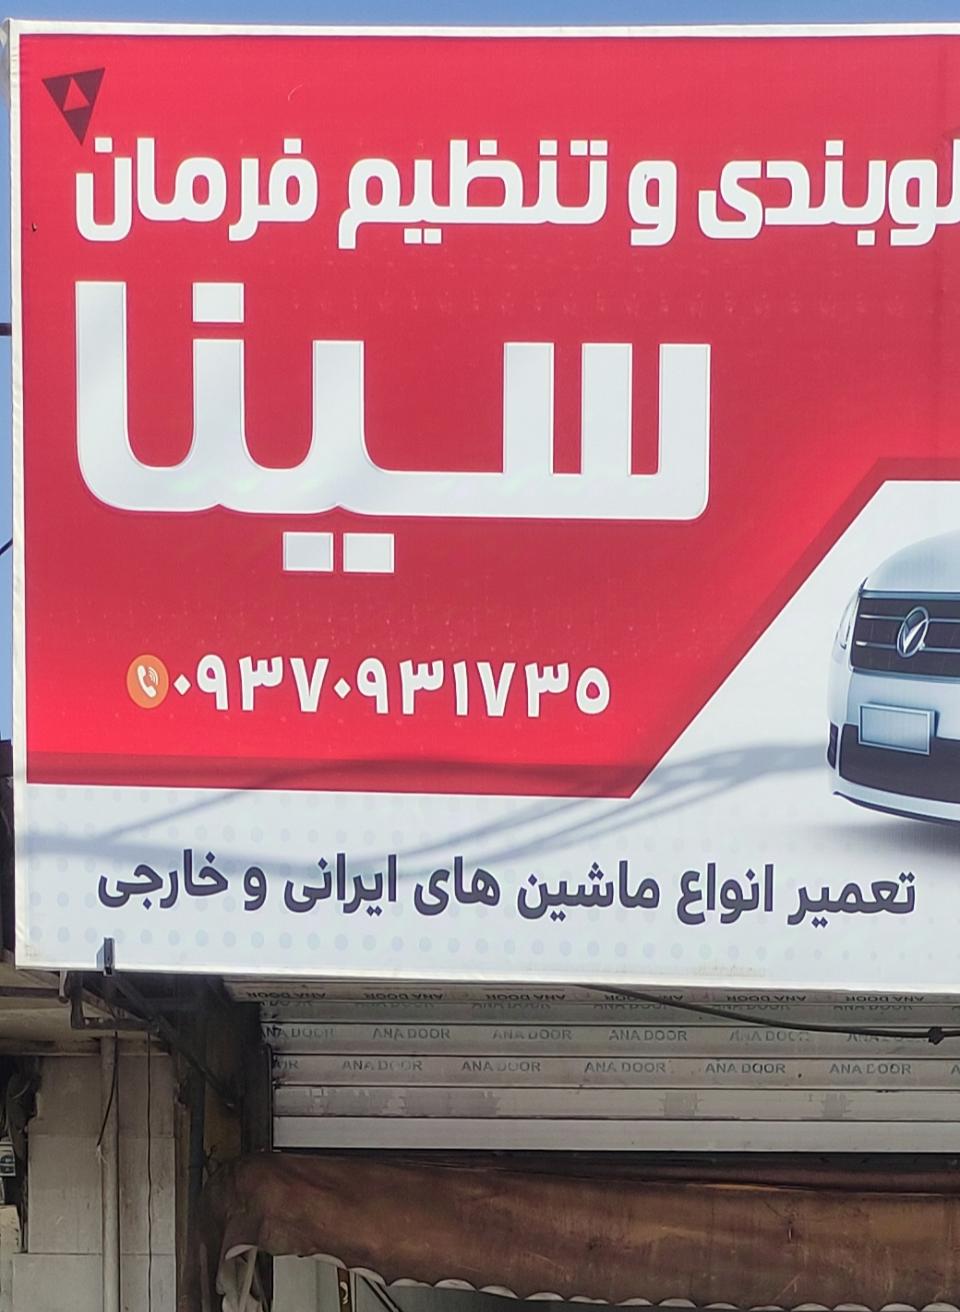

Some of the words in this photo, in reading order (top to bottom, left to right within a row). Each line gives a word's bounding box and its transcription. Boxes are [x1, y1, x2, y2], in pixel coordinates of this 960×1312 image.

[75, 137, 318, 241] فرمان
[337, 139, 609, 250] تنظیم
[627, 159, 678, 248] و
[75, 281, 712, 573] سینا
[173, 654, 611, 717] ۰۹۳۷۰۹۳۱۷۳۵
[97, 848, 229, 910] خارجی
[244, 866, 268, 912] و
[283, 852, 398, 917] ایرانی
[413, 855, 501, 916] های
[517, 860, 661, 922] ماشین
[677, 862, 775, 925] انواع
[787, 871, 916, 929] تعمیر
[372, 1028, 405, 1040] ANA
[408, 1028, 450, 1040] DOOR
[609, 1030, 641, 1041] ANA
[644, 1030, 687, 1041] DOOR
[462, 1061, 494, 1072] ANA
[497, 1061, 541, 1072] DOOR
[584, 1062, 617, 1073] ANA
[622, 1062, 666, 1073] DOOR
[705, 1063, 737, 1074] ANA
[741, 1063, 785, 1074] DOOR
[830, 1063, 862, 1075] ANA
[866, 1063, 912, 1075] DOOR
